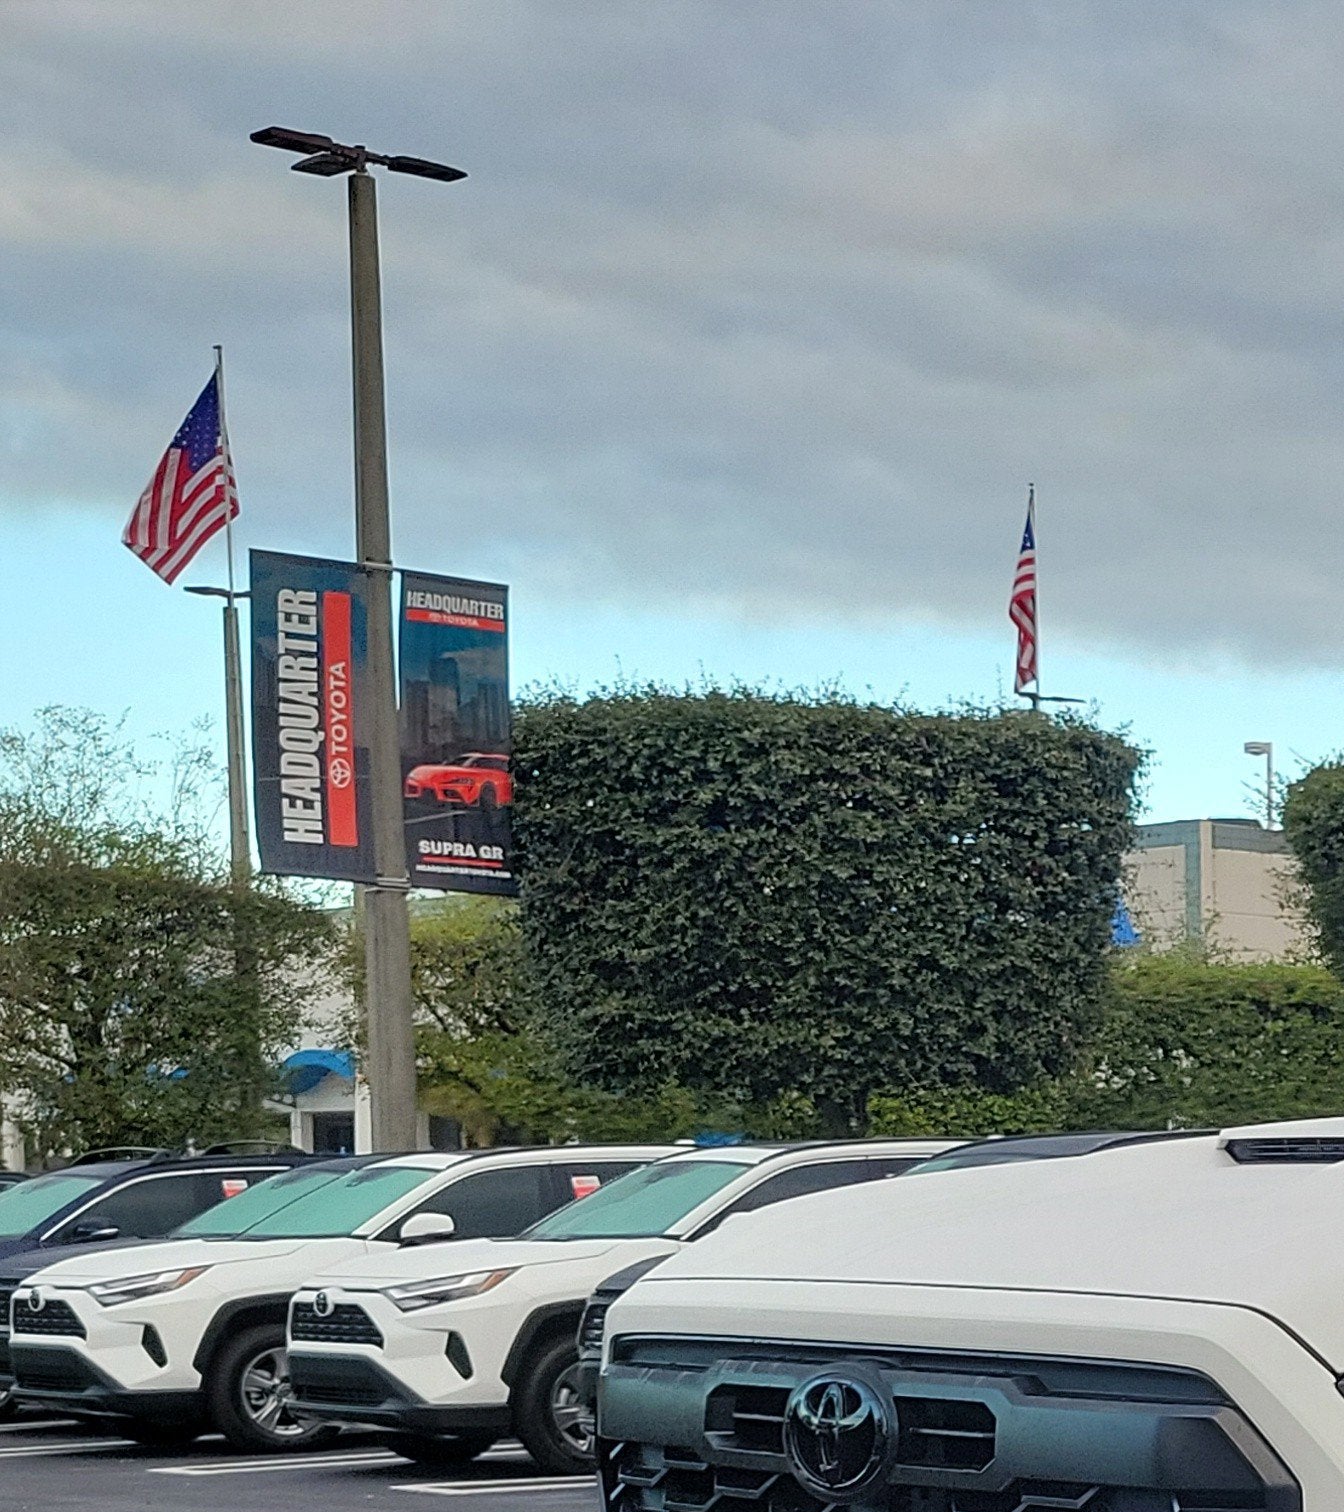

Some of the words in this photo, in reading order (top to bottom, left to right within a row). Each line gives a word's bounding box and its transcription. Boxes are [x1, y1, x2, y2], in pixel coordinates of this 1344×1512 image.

[406, 591, 504, 620] HEADQUARTER
[442, 613, 479, 627] TOYOTA
[277, 587, 325, 845] HEADQUARTER
[329, 661, 348, 755] TOYOTA
[418, 840, 477, 858] SUPRA
[479, 845, 504, 860] GR
